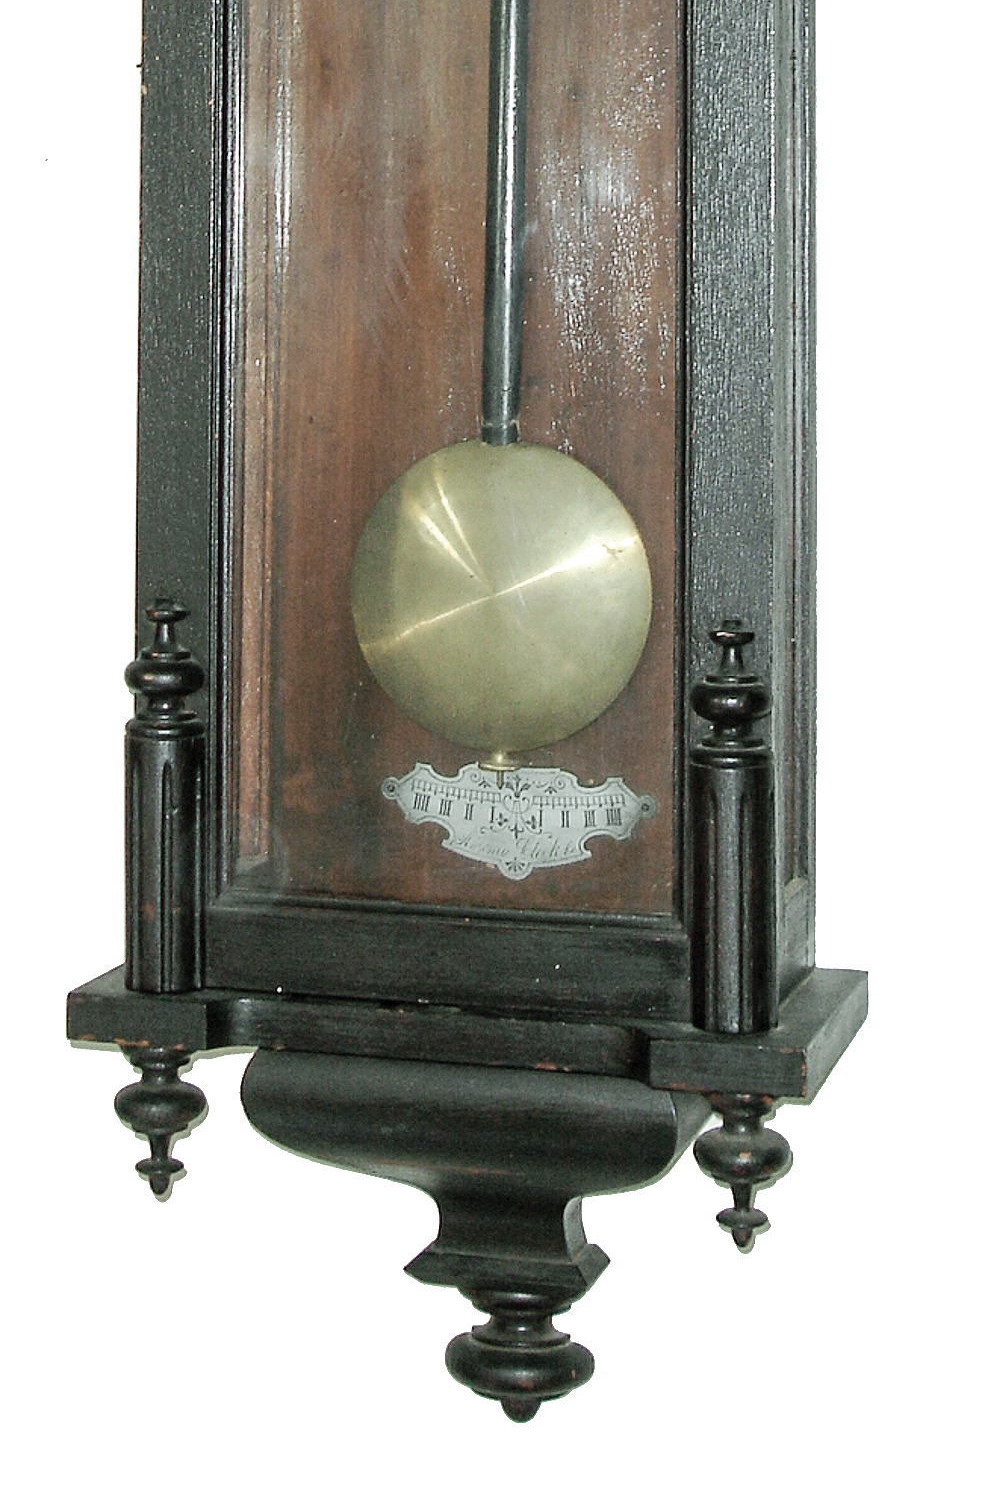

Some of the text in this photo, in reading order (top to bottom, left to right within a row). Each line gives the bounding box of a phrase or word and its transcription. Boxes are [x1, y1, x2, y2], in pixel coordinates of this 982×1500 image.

[439, 799, 451, 817] III
[464, 803, 473, 820] II
[490, 806, 495, 824] I
[538, 809, 543, 827] I
[561, 810, 570, 828] II
[584, 809, 596, 828] III
